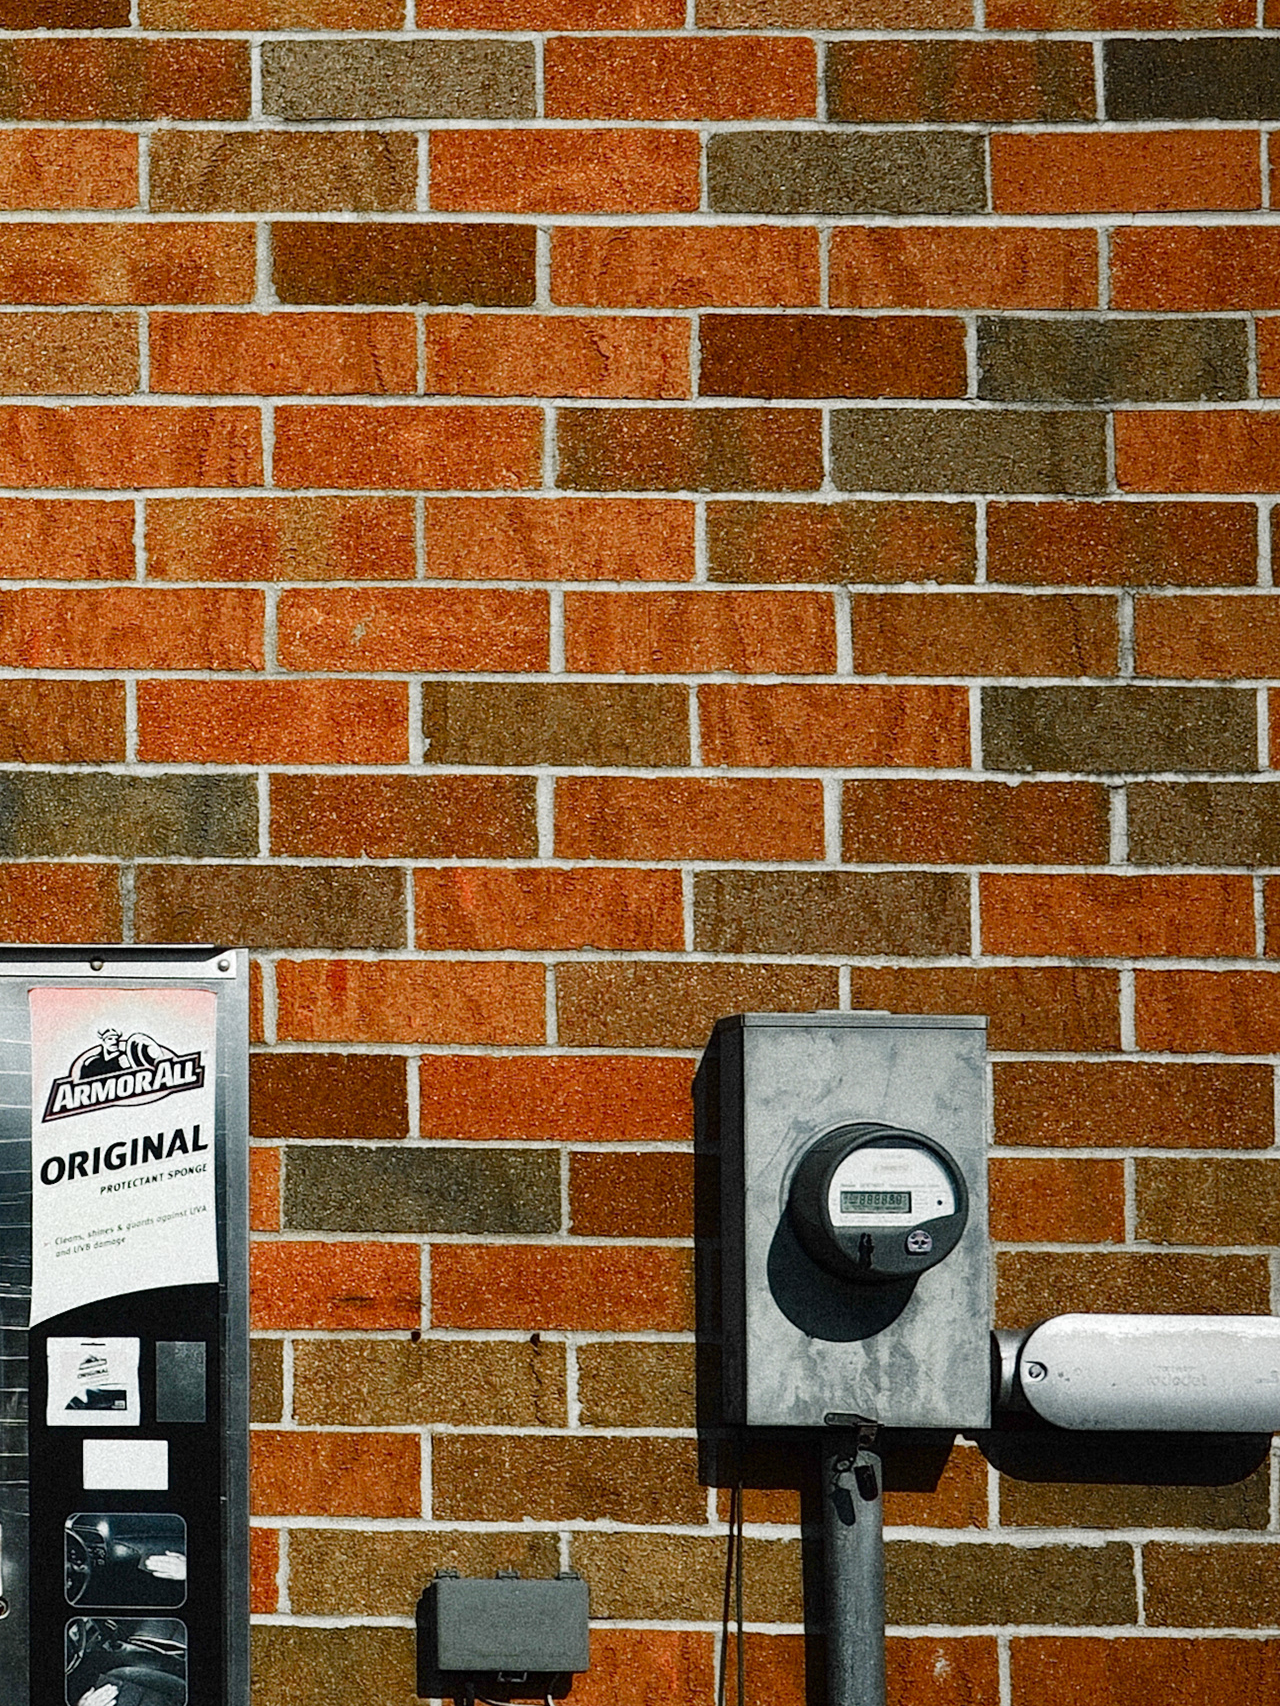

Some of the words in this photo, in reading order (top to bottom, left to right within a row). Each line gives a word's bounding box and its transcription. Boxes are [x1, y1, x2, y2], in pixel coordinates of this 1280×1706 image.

[39, 1124, 209, 1186] ORIGINAL
[99, 1172, 164, 1196] PROTECTANT
[167, 1162, 208, 1181] SPONGE
